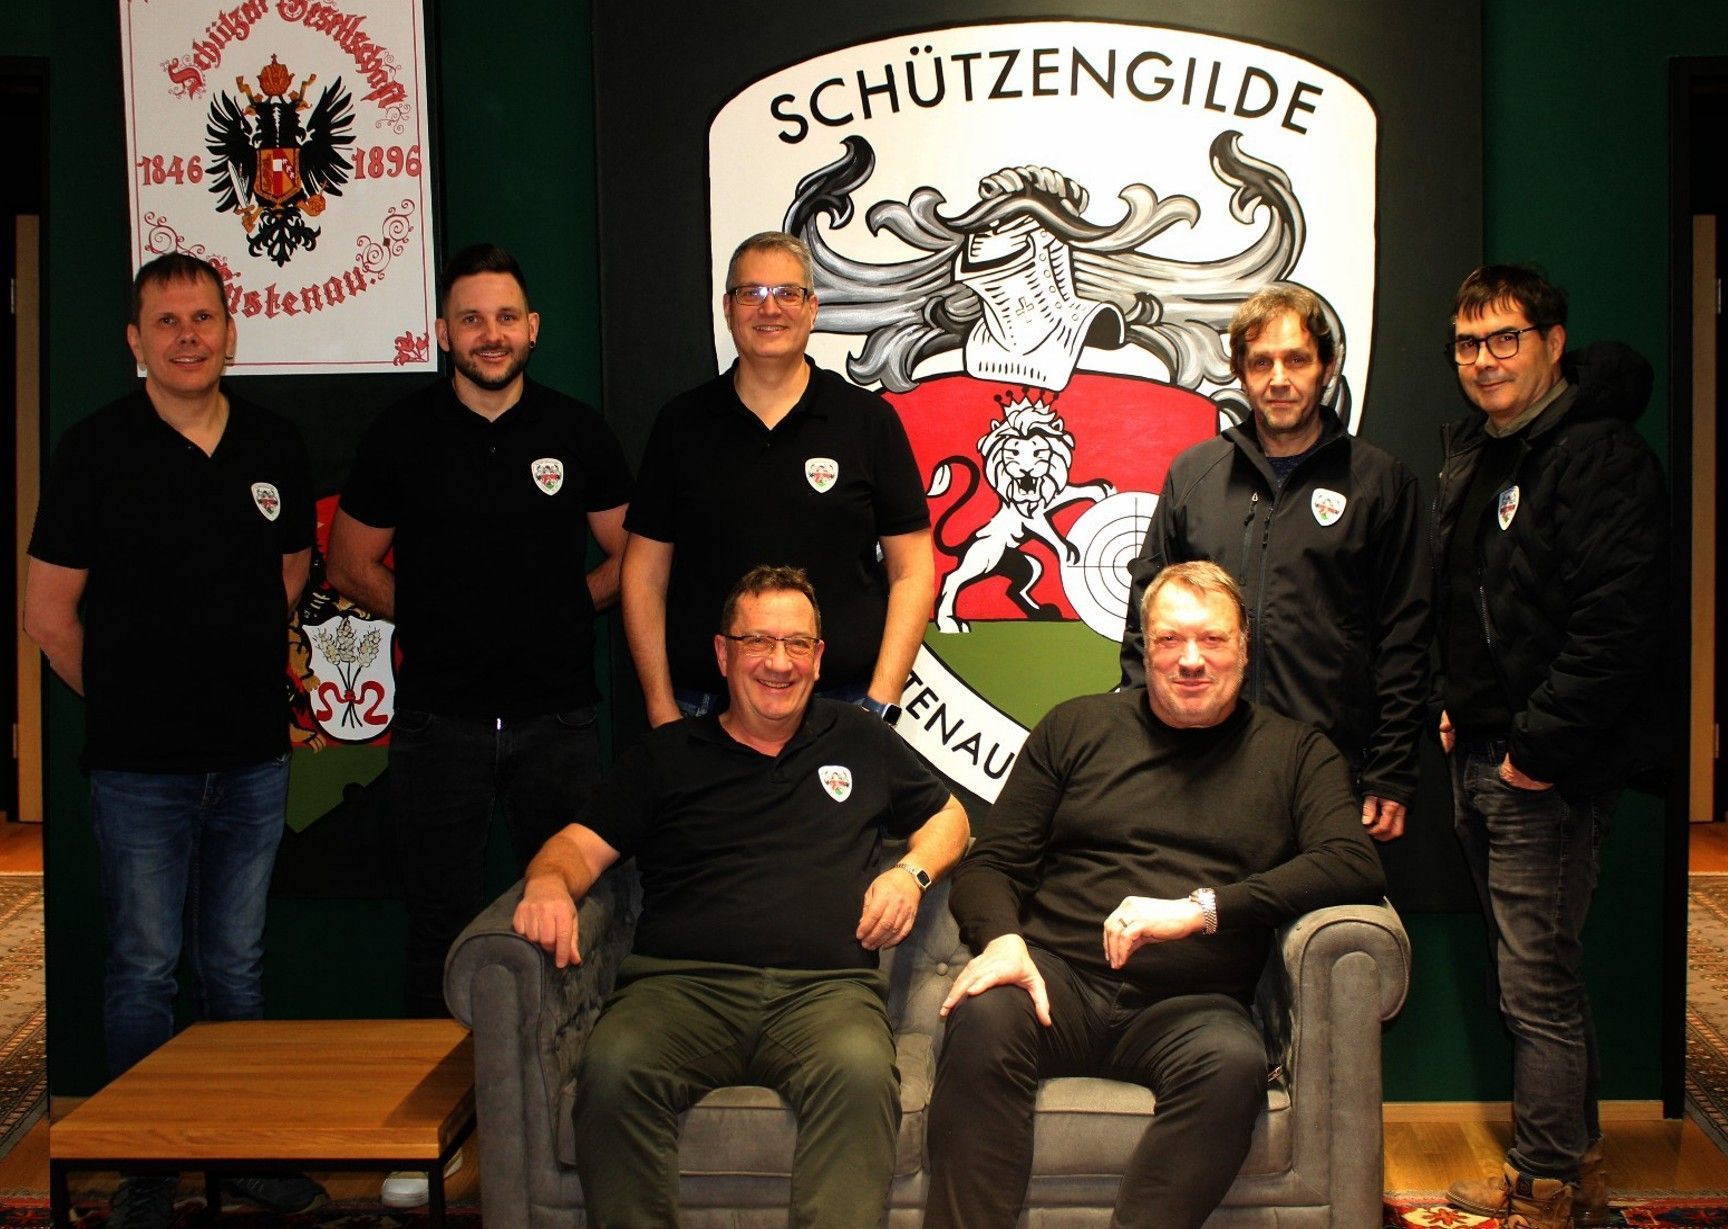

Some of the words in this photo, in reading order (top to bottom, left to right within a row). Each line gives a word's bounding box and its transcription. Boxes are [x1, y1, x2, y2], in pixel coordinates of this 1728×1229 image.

[769, 46, 1324, 144] SCHÜTZENGILDE
[136, 154, 204, 186] 1846
[350, 145, 422, 180] 1896
